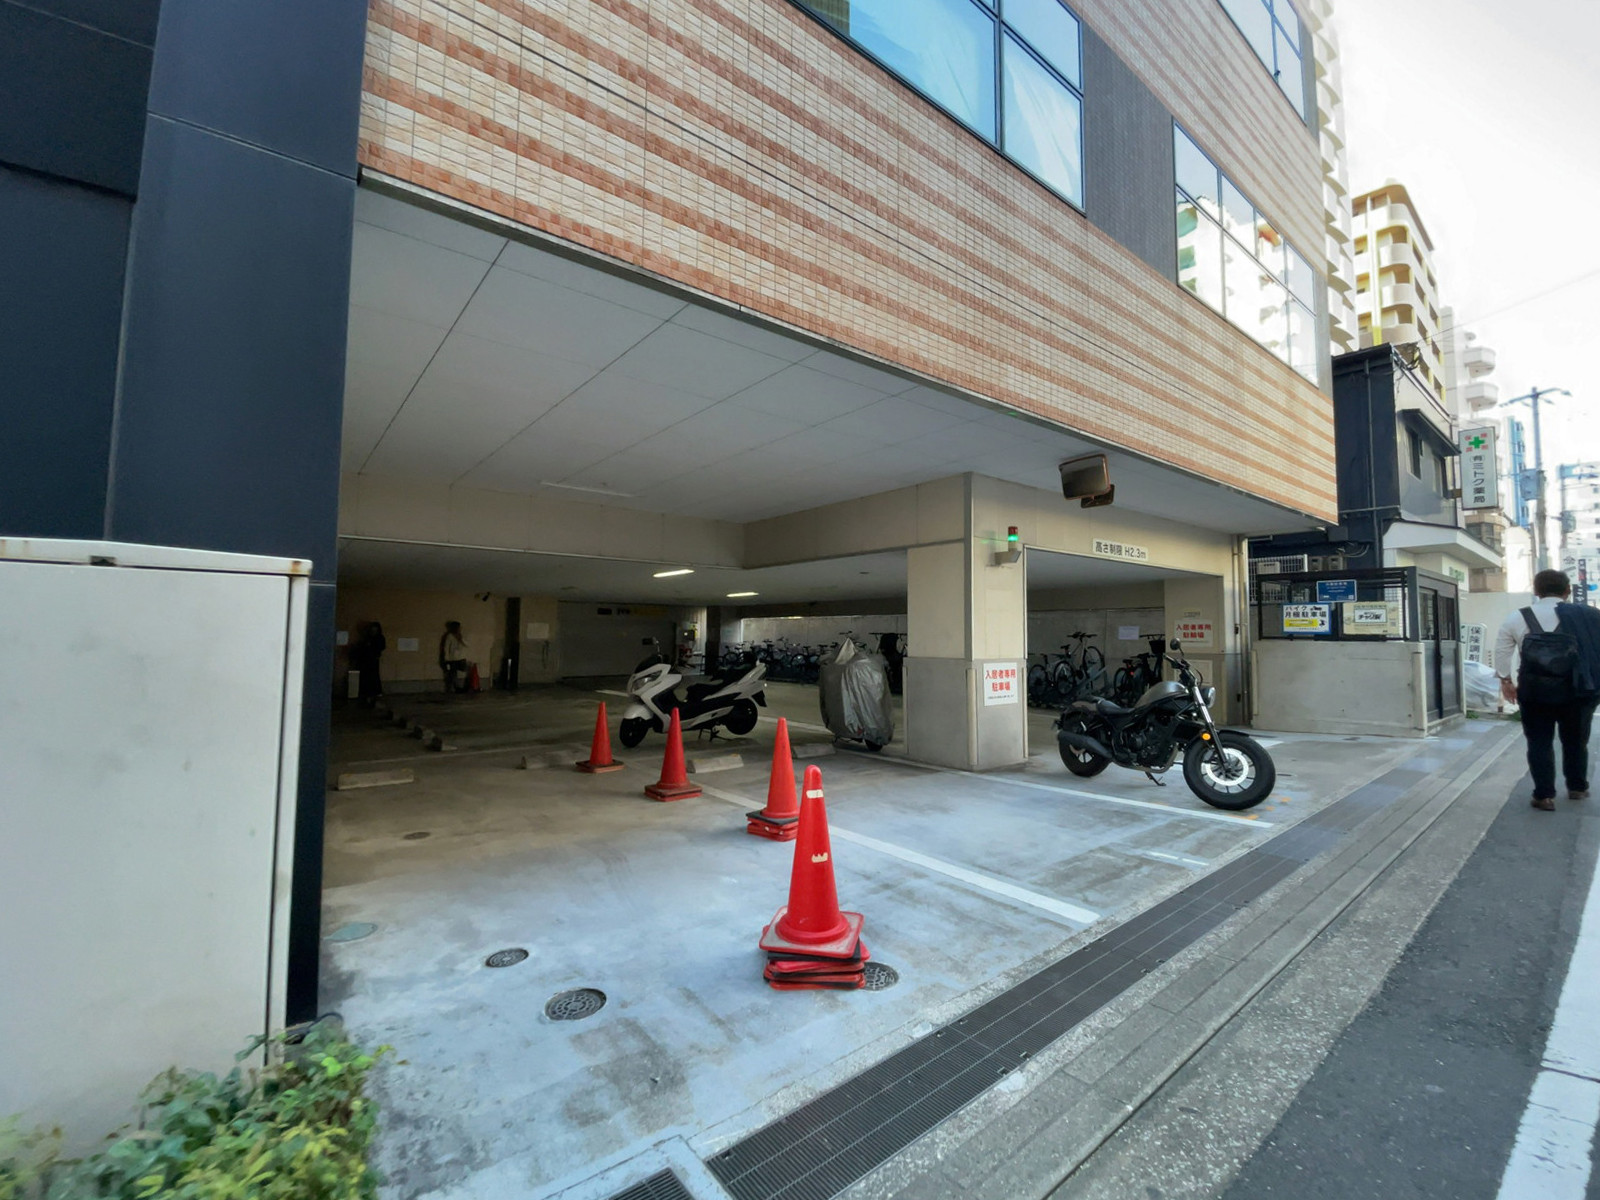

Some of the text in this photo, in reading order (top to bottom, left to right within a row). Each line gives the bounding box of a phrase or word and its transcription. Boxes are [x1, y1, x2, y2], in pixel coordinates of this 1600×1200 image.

[1096, 541, 1122, 556] 高さ制限
[1468, 626, 1482, 663] 保険調剤
[985, 669, 1017, 680] 入居者専用
